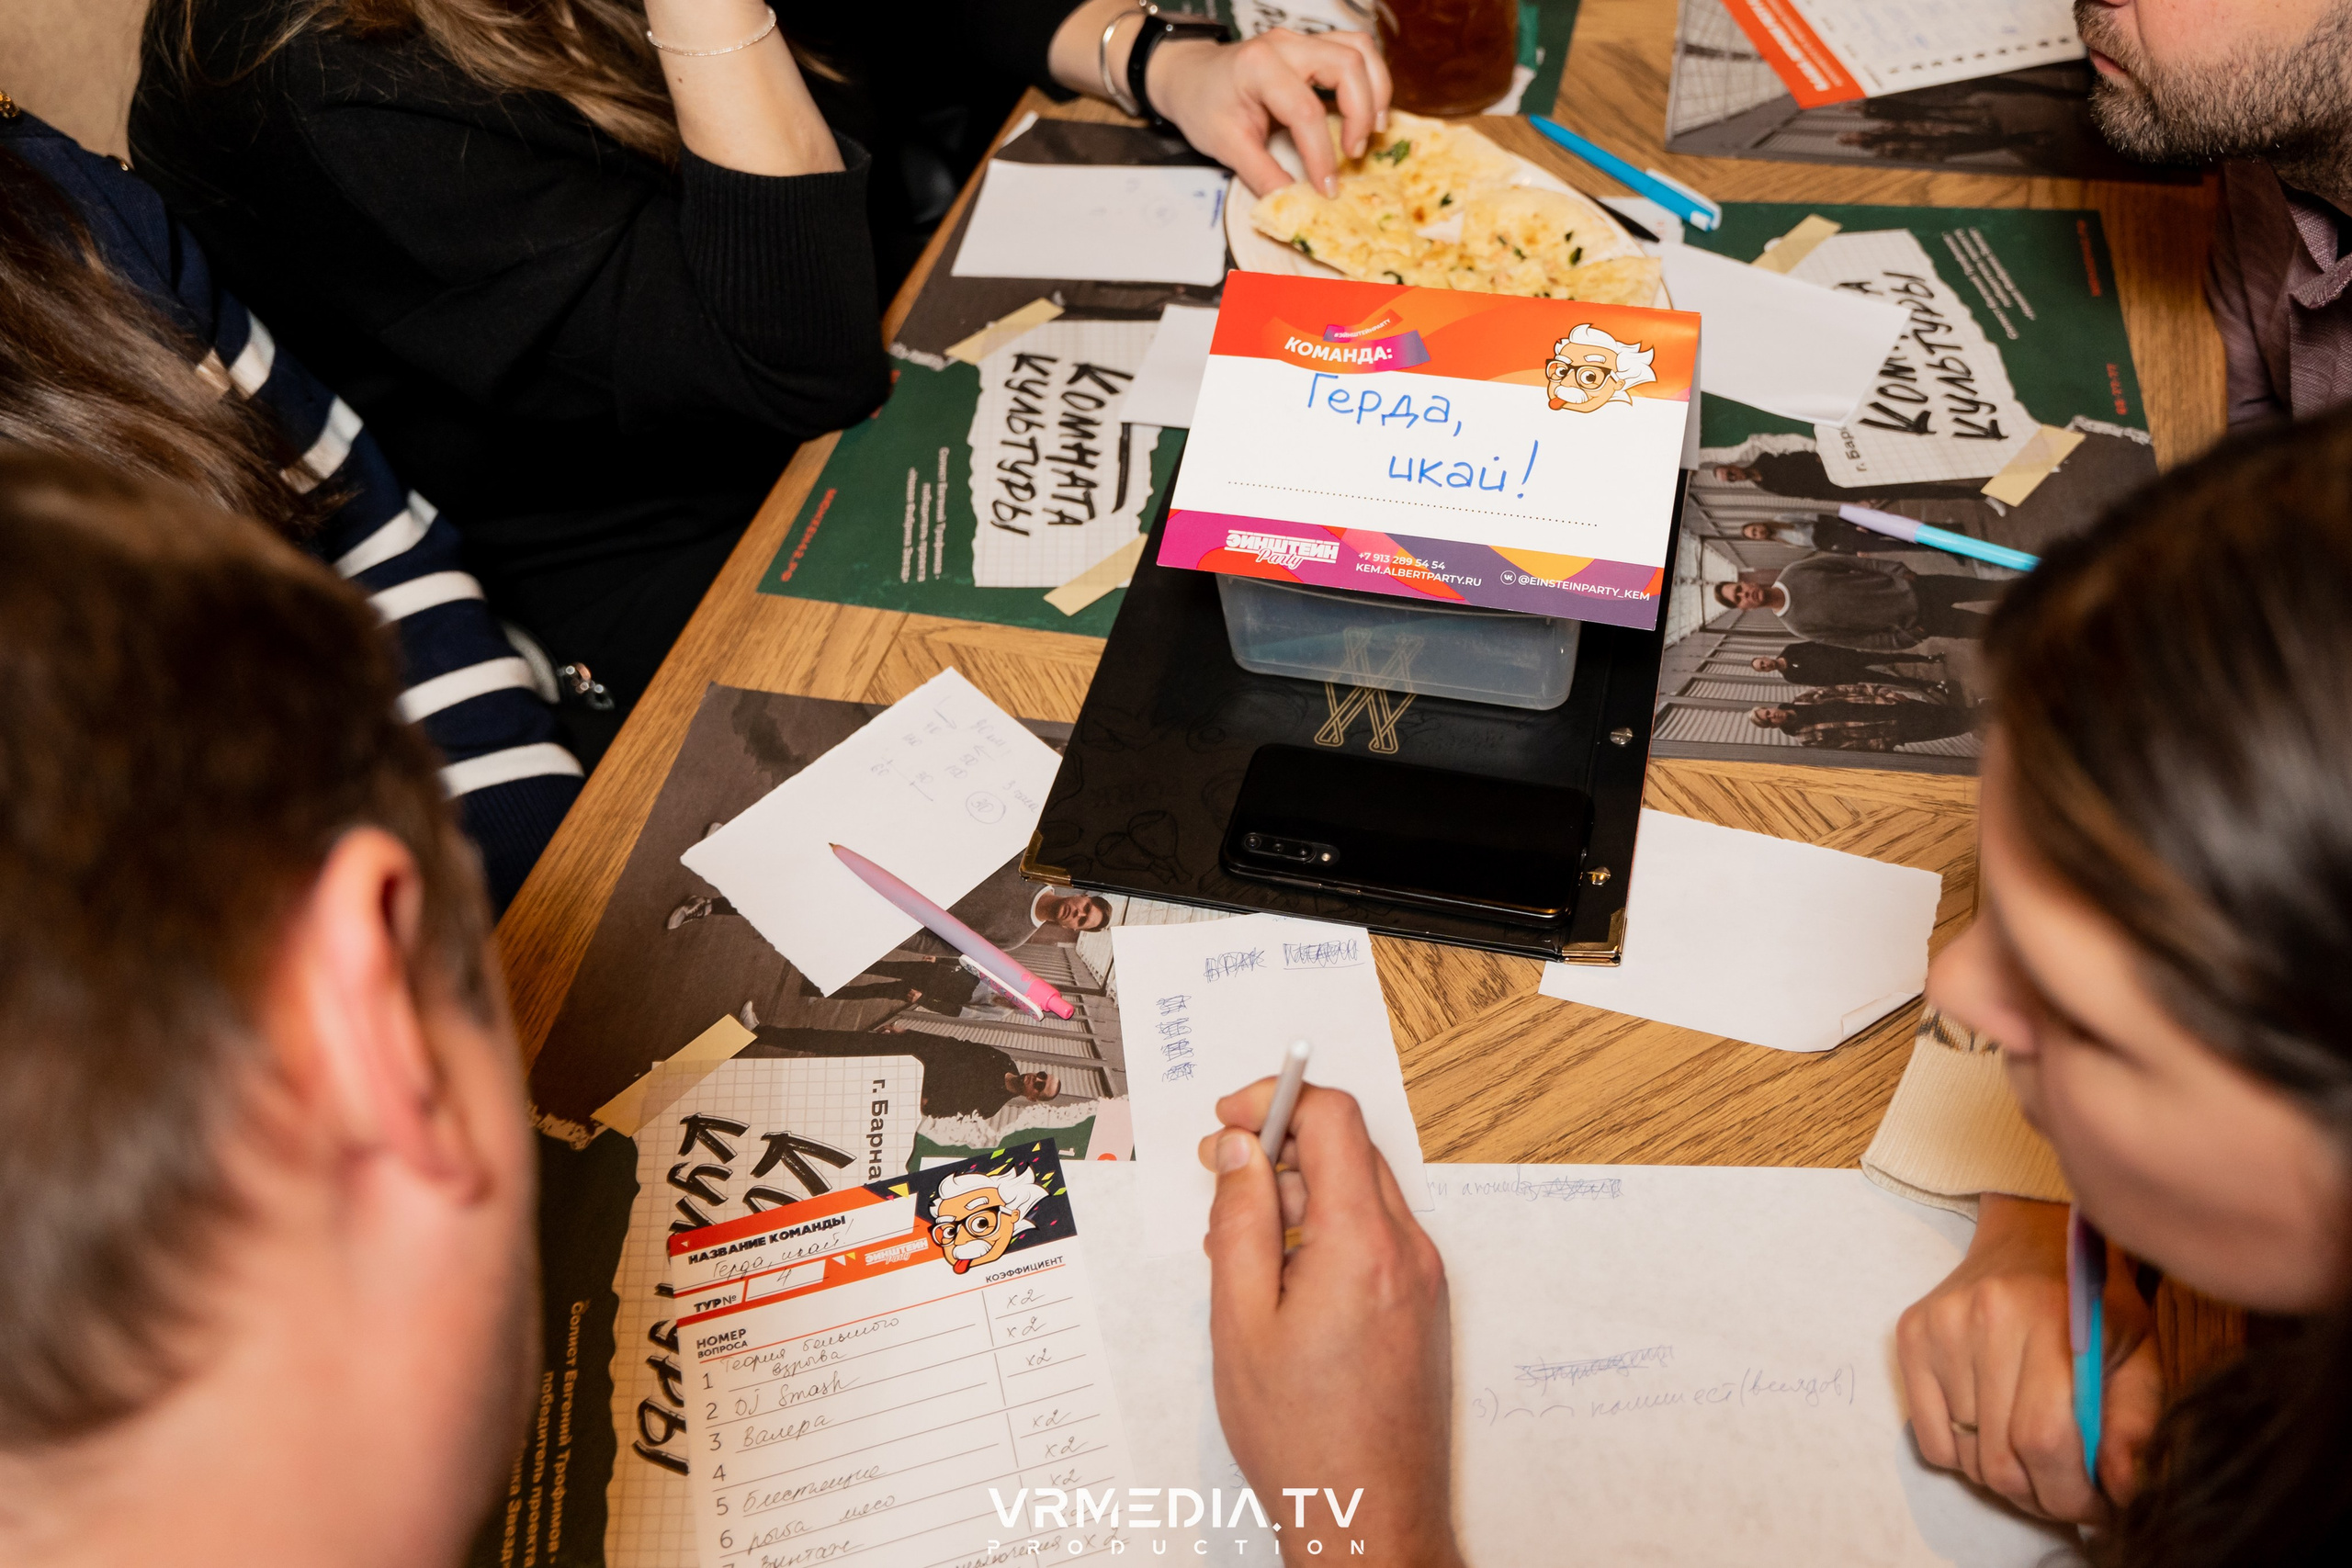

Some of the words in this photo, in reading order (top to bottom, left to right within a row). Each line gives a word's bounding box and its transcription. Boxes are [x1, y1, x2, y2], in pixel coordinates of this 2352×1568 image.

[1284, 336, 1394, 366] КОМАНДА:
[1307, 372, 1464, 436] Герда,
[989, 353, 1059, 537] КУЛЬТУРЫ
[1043, 363, 1135, 526] КОМНАТА
[1387, 439, 1540, 500] икай!
[1255, 547, 1306, 570] Party
[1358, 552, 1372, 562] +7
[1375, 553, 1391, 564] 913
[1392, 555, 1413, 567] 289
[1414, 558, 1430, 569] 54
[1430, 560, 1446, 571] 54
[1355, 562, 1482, 588] KEM.ALBERTPARTY.RU
[1518, 574, 1651, 602] @EINSTEINPARTY_KEM
[871, 1077, 887, 1094] г.
[865, 1099, 889, 1185] Барна
[687, 1235, 767, 1265] НАЗВАНИЕ
[769, 1215, 846, 1244] КОМАНДЫ
[986, 1256, 1064, 1283] КОЭФФИЦИЕНТ
[565, 1300, 584, 1367] Солист
[695, 1328, 747, 1349] НОМЕР
[697, 1340, 749, 1359] ВОПРОСА
[702, 1372, 714, 1391] 1
[558, 1369, 579, 1448] Евгений
[706, 1402, 718, 1421] 2
[708, 1432, 722, 1451] 3
[742, 1414, 835, 1449] Валера
[712, 1463, 727, 1483] 4
[548, 1449, 571, 1553] Трофимов
[716, 1496, 729, 1516] 5
[524, 1485, 543, 1568] проекта
[719, 1529, 733, 1550] 6
